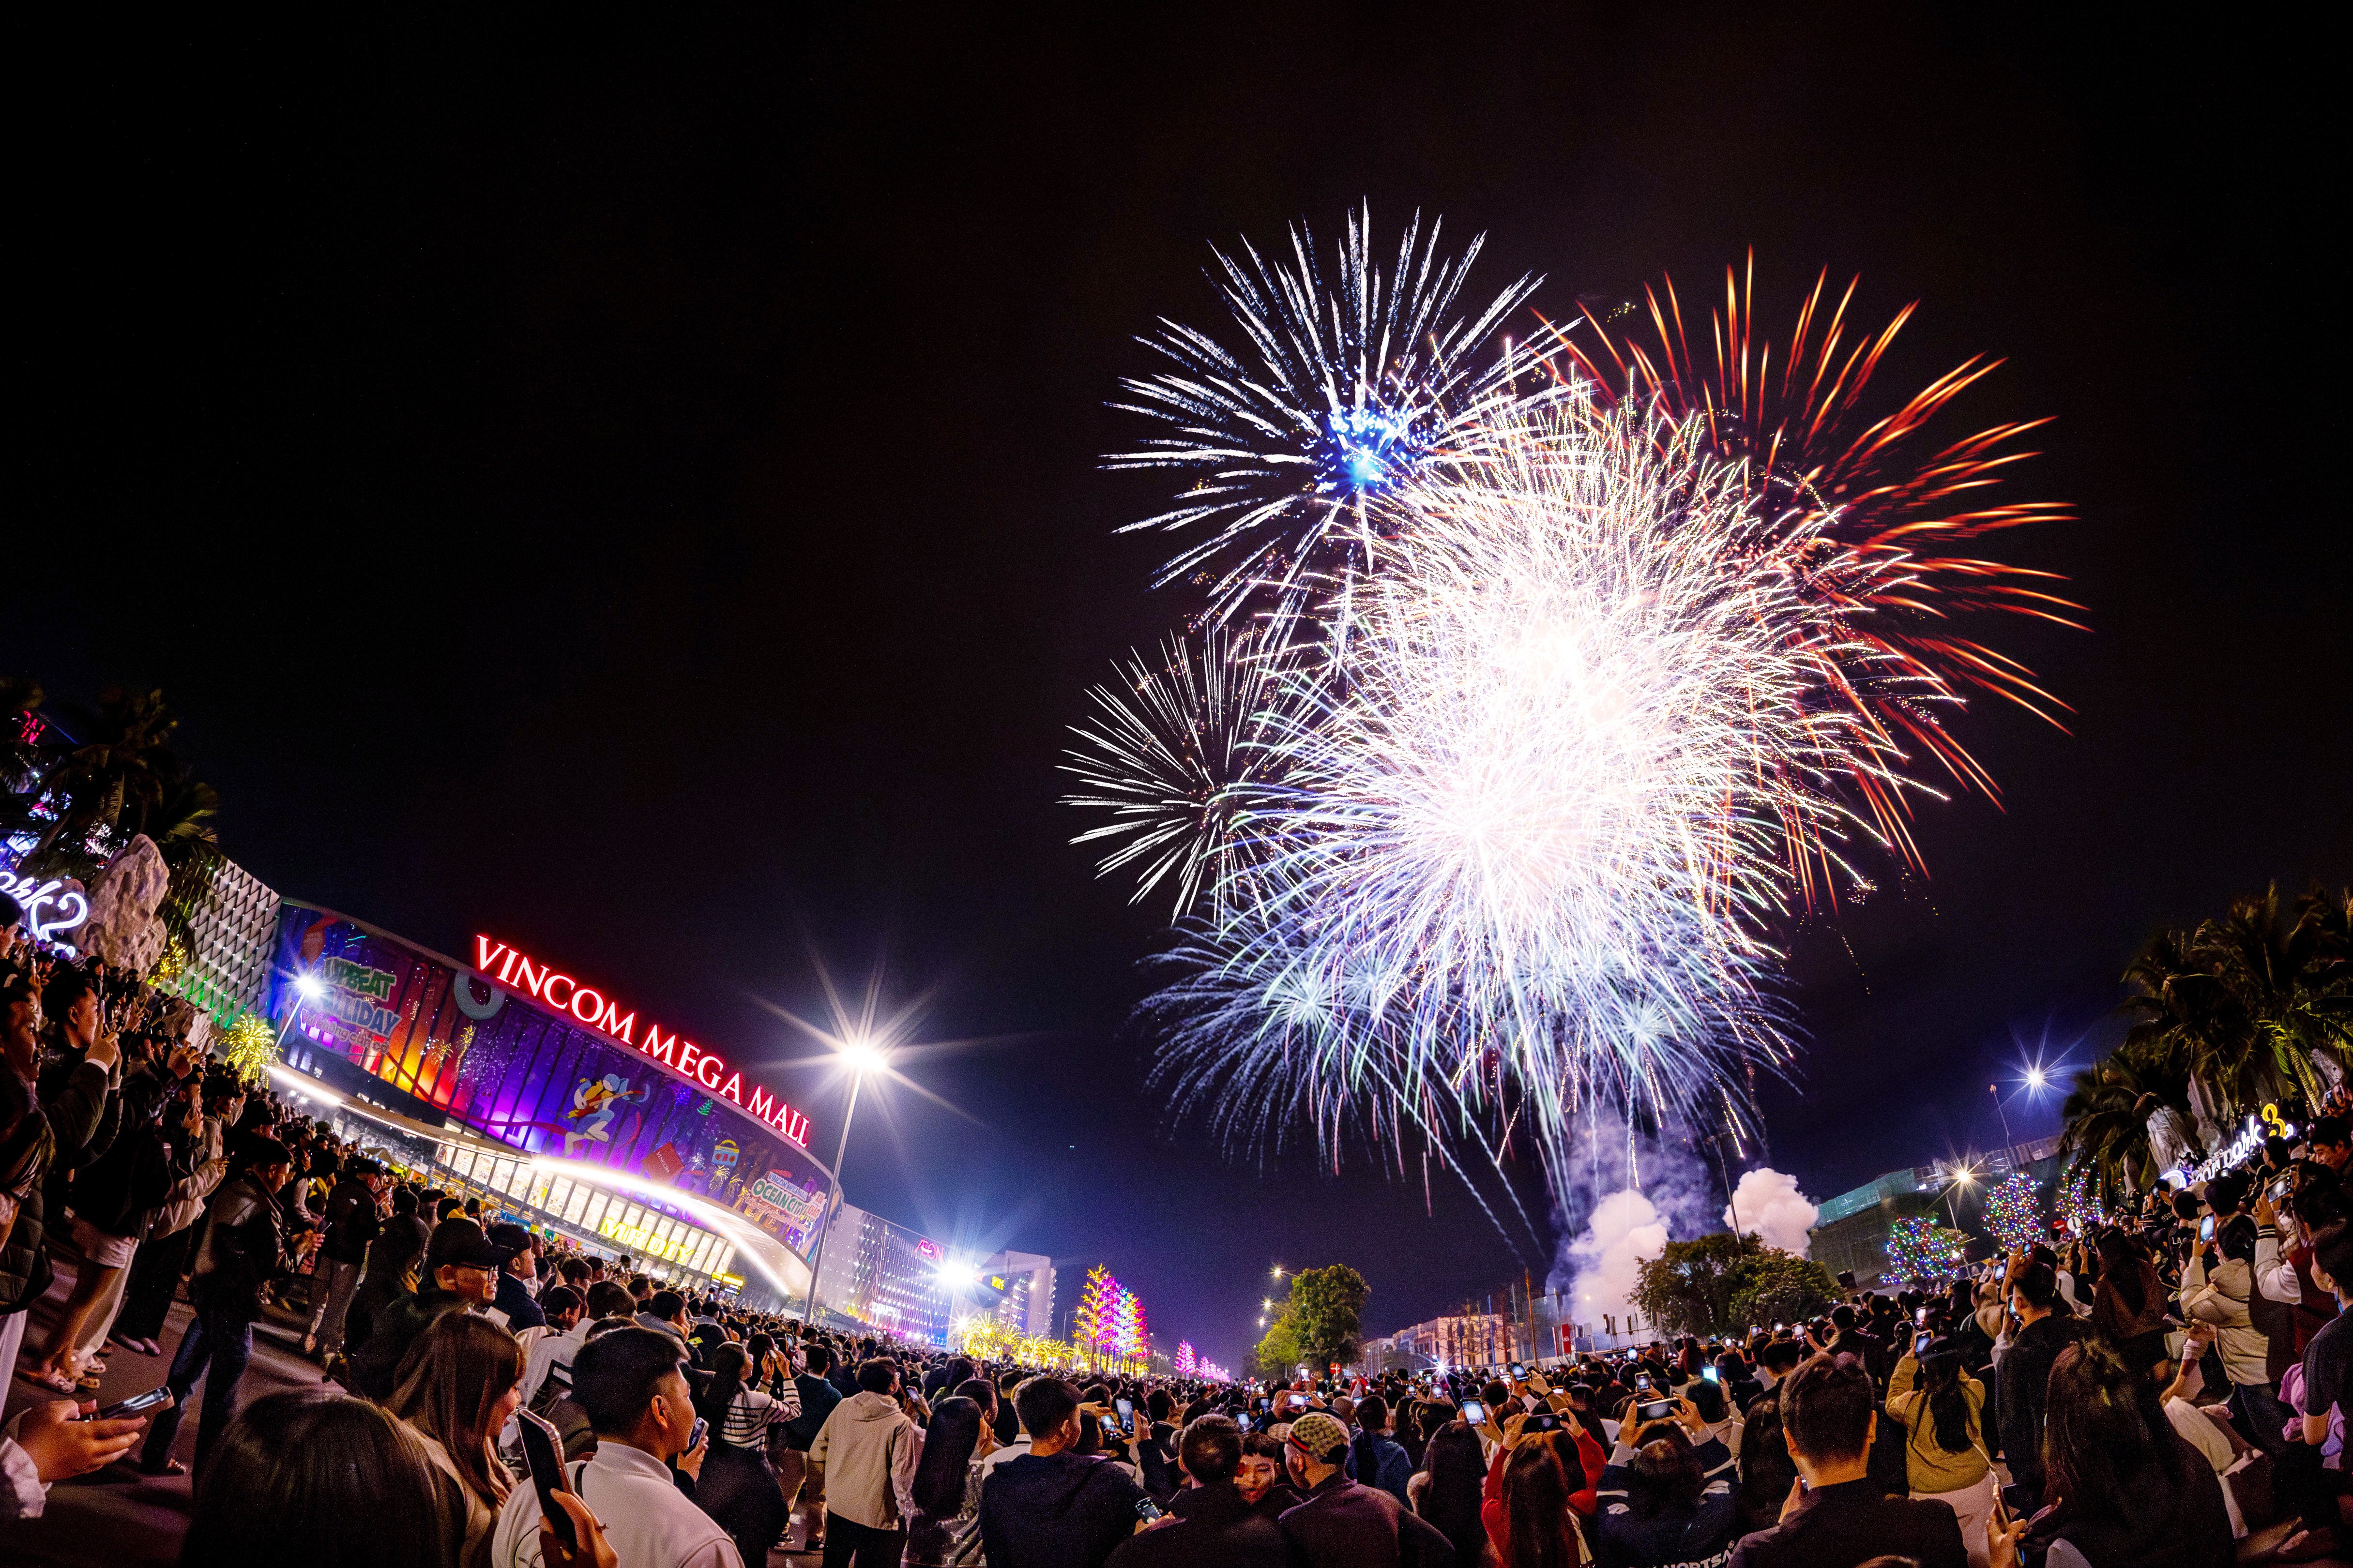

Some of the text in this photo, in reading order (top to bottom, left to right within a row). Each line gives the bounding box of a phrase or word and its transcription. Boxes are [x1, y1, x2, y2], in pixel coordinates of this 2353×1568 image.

[476, 935, 810, 1148] VINCOM MEGA MALL
[753, 1180, 790, 1208] OCEAN
[786, 1198, 807, 1216] CITY
[2172, 1236, 2183, 1247] LA
